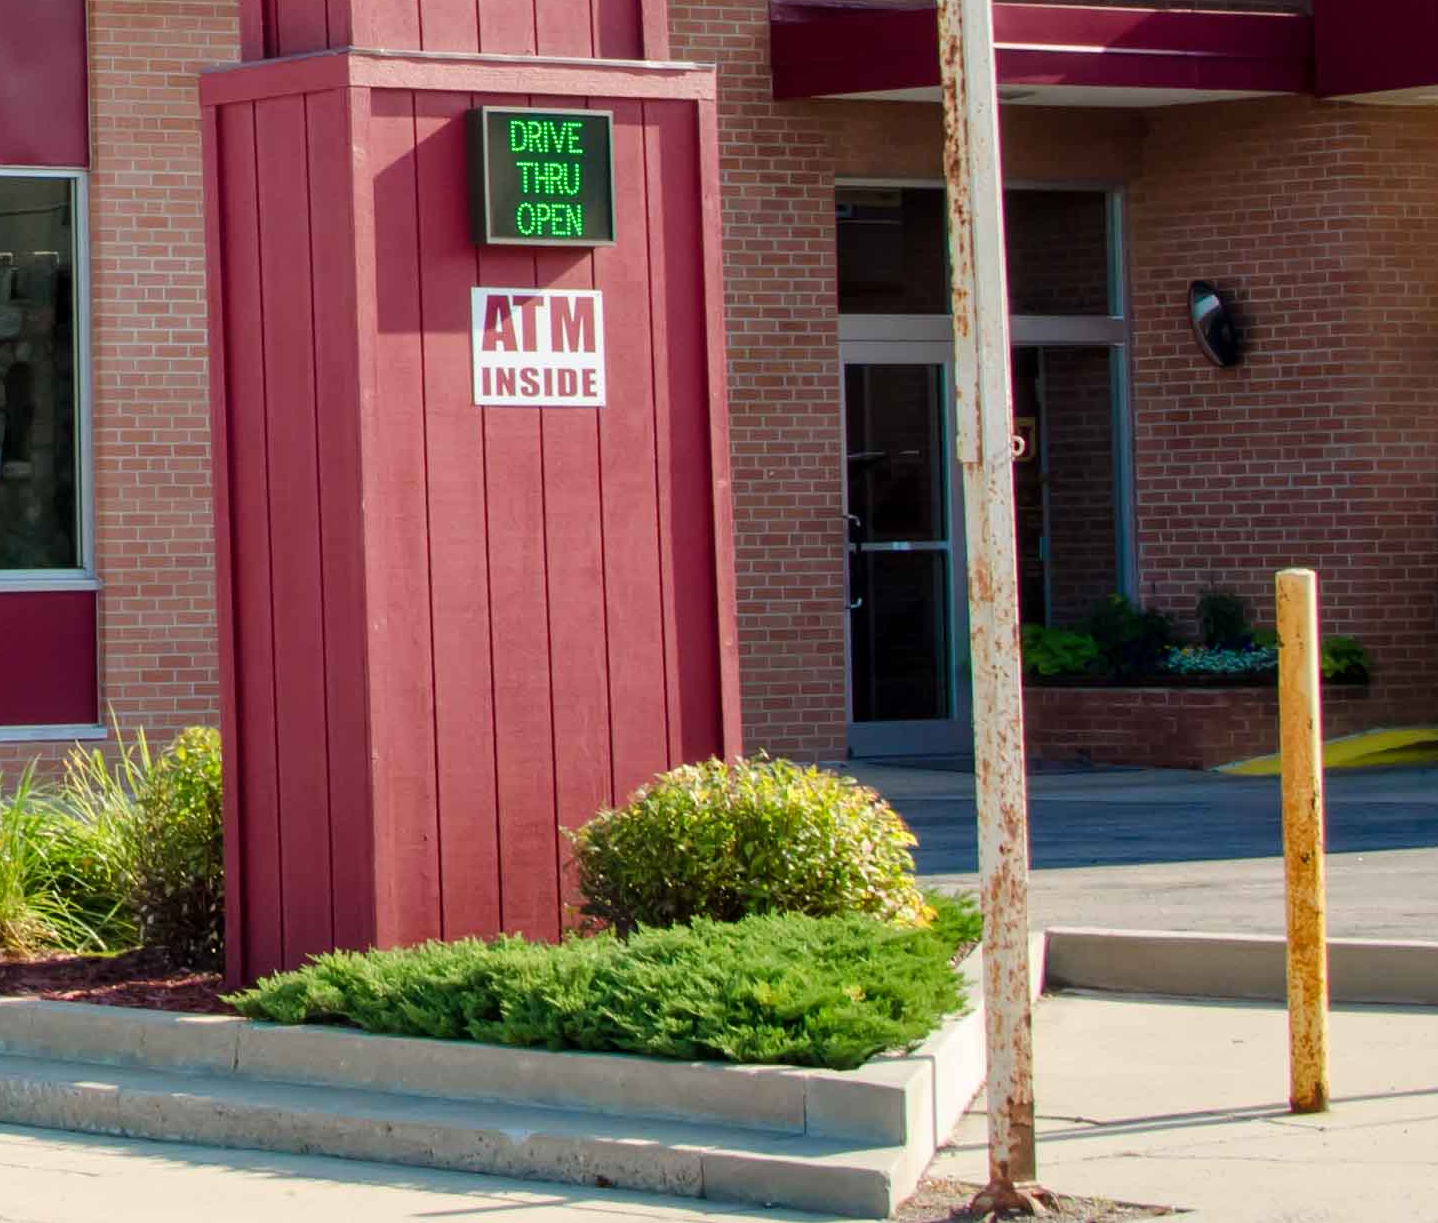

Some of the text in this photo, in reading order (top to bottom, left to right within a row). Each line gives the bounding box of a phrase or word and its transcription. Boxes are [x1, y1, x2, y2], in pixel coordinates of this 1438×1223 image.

[510, 120, 584, 154] DRIVE
[516, 162, 581, 195] THRU
[516, 202, 583, 236] OPEN
[481, 294, 597, 354] ATM
[481, 366, 599, 398] INSIDE
